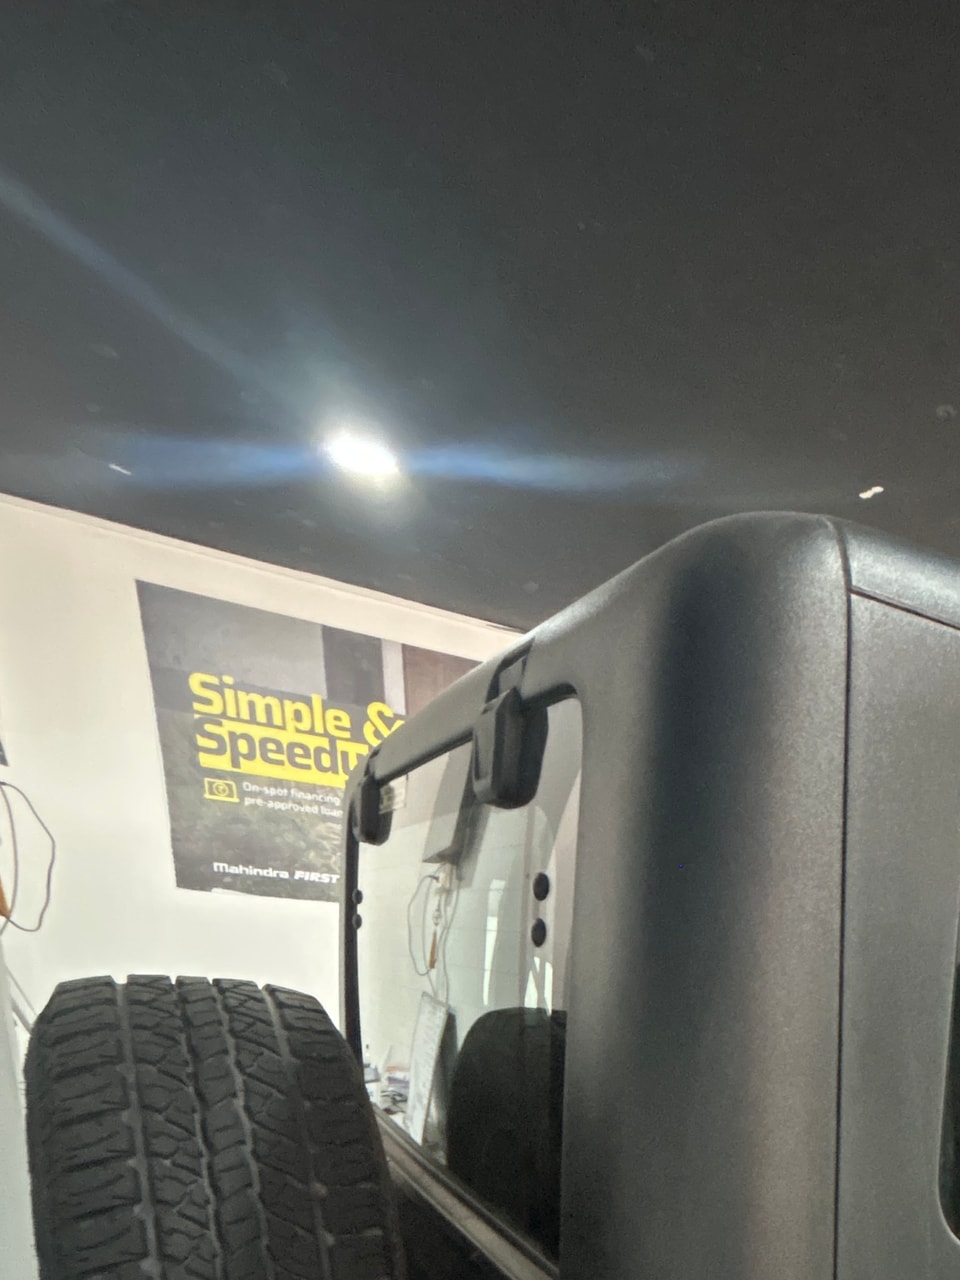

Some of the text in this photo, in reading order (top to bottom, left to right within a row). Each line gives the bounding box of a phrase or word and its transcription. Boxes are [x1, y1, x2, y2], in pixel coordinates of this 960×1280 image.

[189, 672, 404, 747] Simple &
[242, 781, 341, 806] On-spot financing
[244, 797, 318, 814] pre-approved
[294, 869, 340, 884] FIRST
